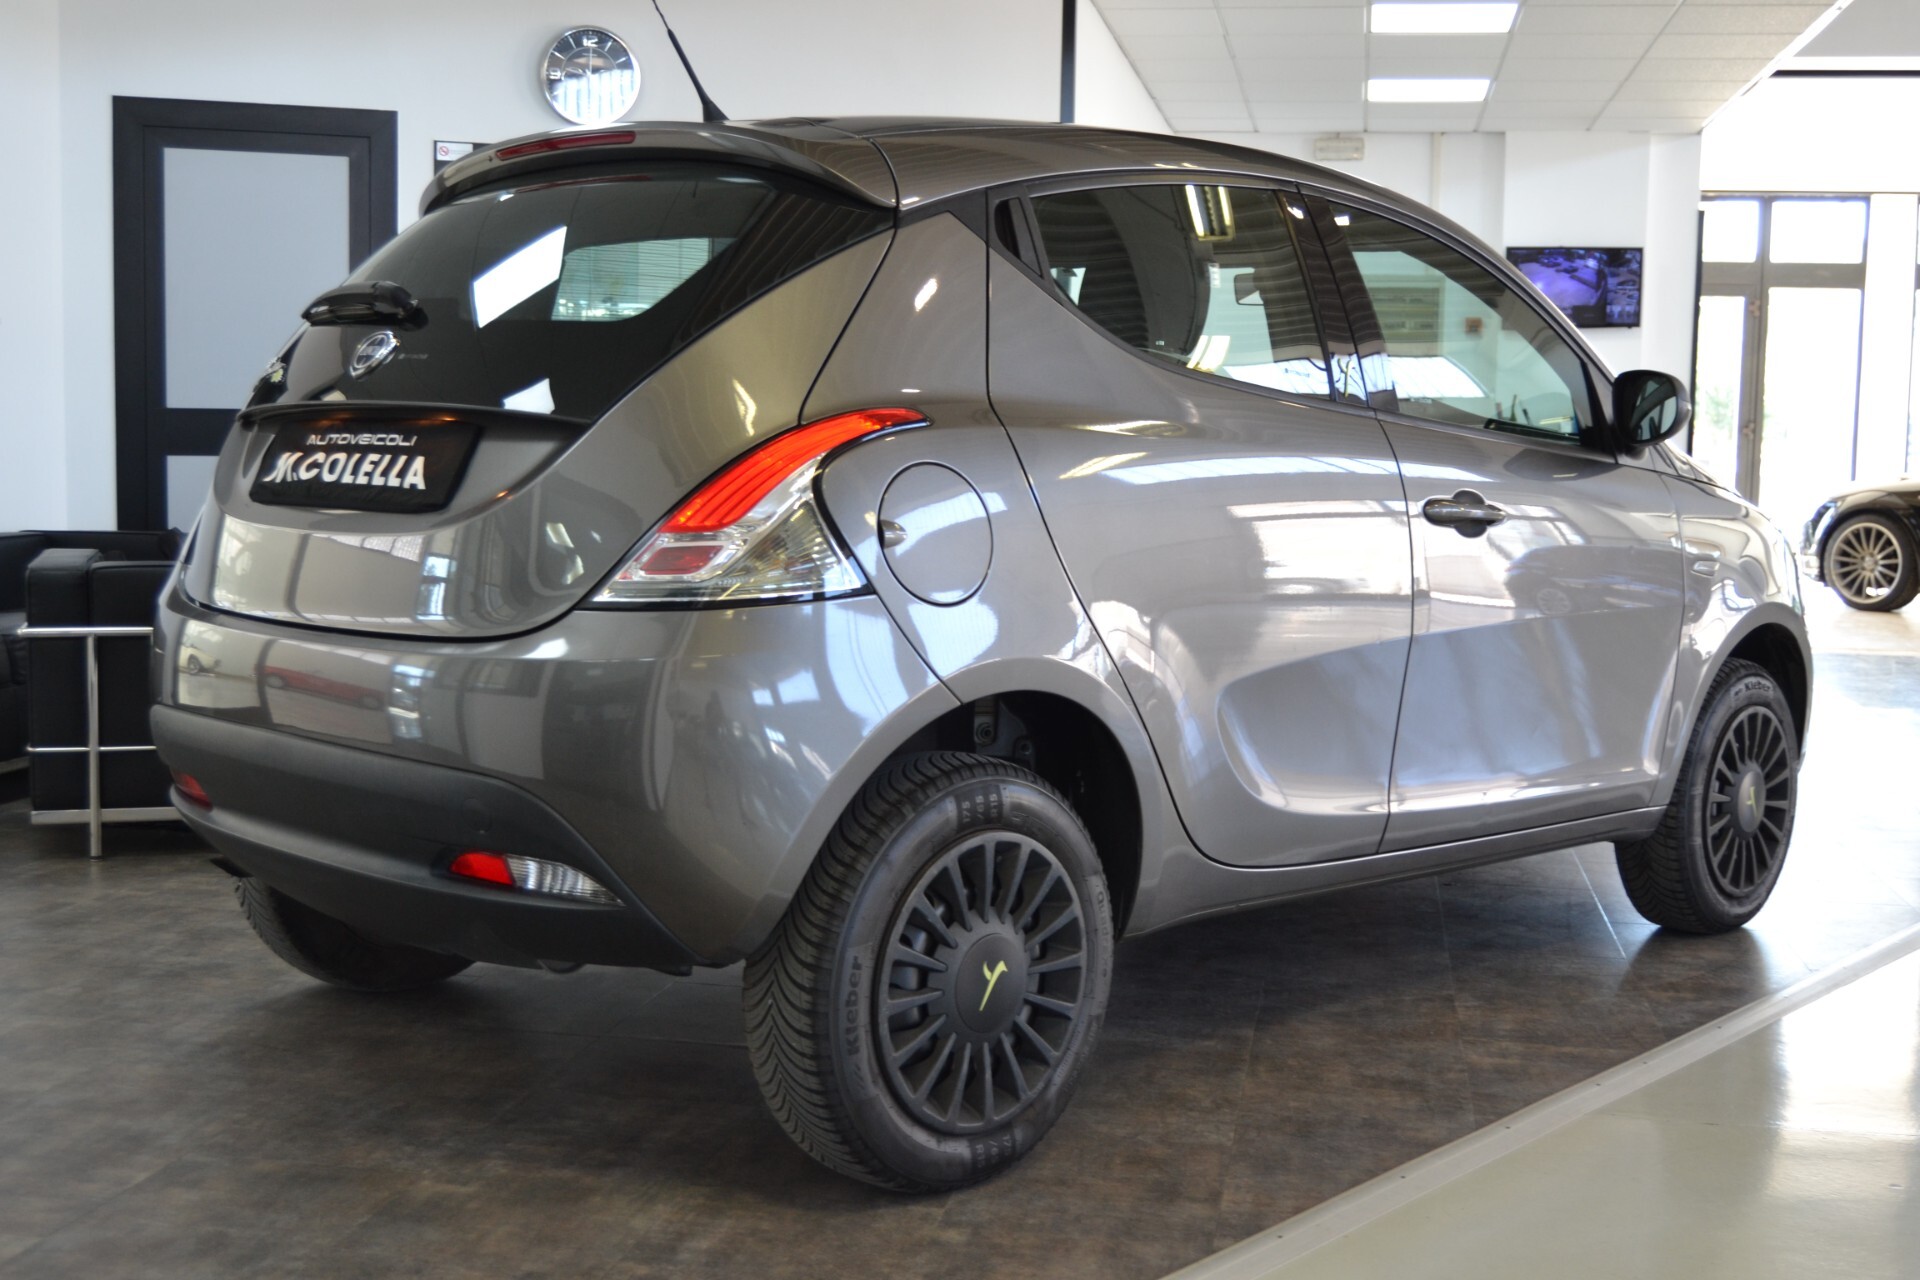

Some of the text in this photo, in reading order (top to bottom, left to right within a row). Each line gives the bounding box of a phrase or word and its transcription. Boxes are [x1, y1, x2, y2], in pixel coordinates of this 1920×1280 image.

[582, 35, 598, 47] 12
[306, 433, 418, 447] AUTOVEICOLI
[844, 955, 863, 1057] Kleber
